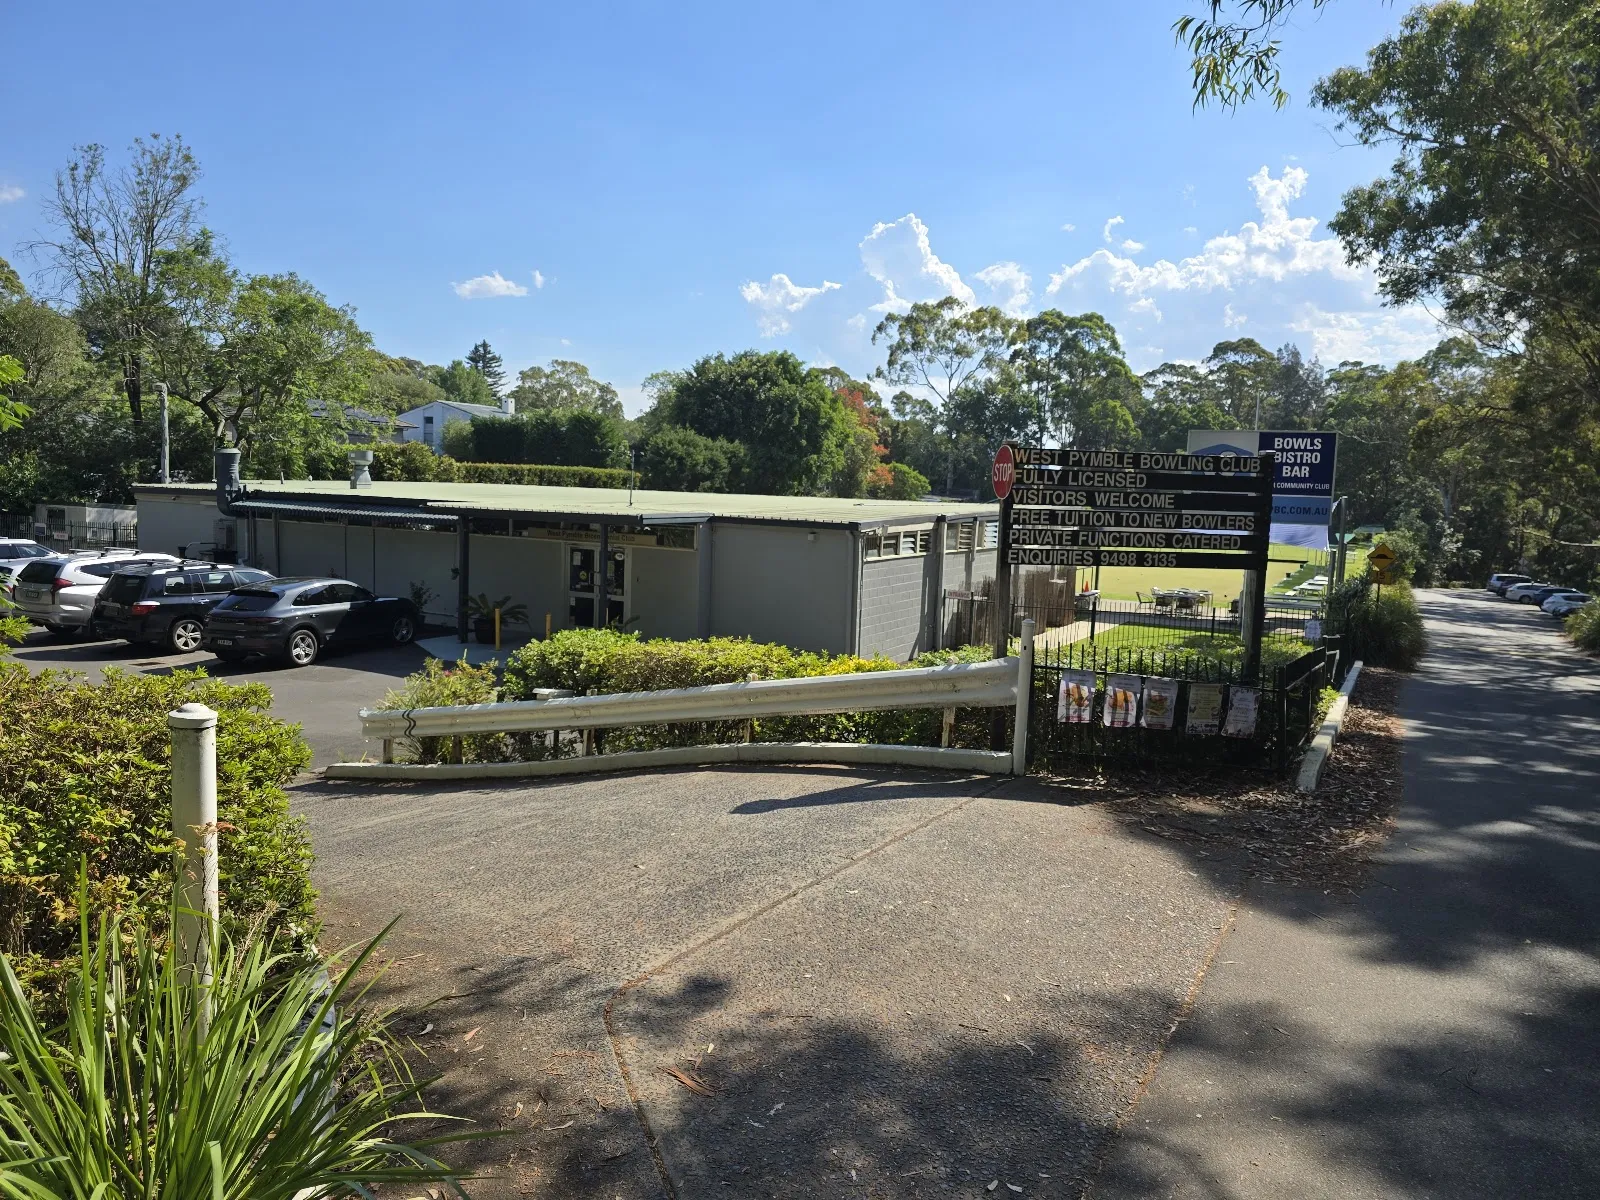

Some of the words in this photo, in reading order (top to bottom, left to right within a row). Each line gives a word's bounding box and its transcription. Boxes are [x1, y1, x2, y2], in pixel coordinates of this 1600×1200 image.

[1274, 437, 1322, 450] BOWLS
[1014, 448, 1062, 466] WEST
[1068, 451, 1134, 468] PYMBLE
[1140, 455, 1214, 471] BOWLING
[1220, 457, 1260, 472] CLUB
[1274, 451, 1321, 464] BISTRO
[993, 463, 1012, 482] STOP
[1013, 469, 1062, 485] FULLY
[1068, 471, 1147, 488] LICENSED
[1282, 465, 1310, 478] BAR
[1012, 489, 1087, 506] VISITORS
[1094, 491, 1175, 508] WELCOME
[1010, 509, 1050, 524] FREE
[1055, 510, 1115, 526] TUITION
[1120, 512, 1140, 527] TO
[1143, 513, 1178, 528] NEW
[1181, 515, 1255, 530] BOWLERS
[1271, 506, 1328, 516] BC.COM.AU
[1009, 530, 1073, 546] PRIVATE
[1078, 532, 1166, 547] FUNCTIONS
[1172, 534, 1241, 549] CATERED
[1007, 550, 1094, 565] ENQUIRIES
[1100, 552, 1137, 566] 9498
[1143, 553, 1177, 567] 3135
